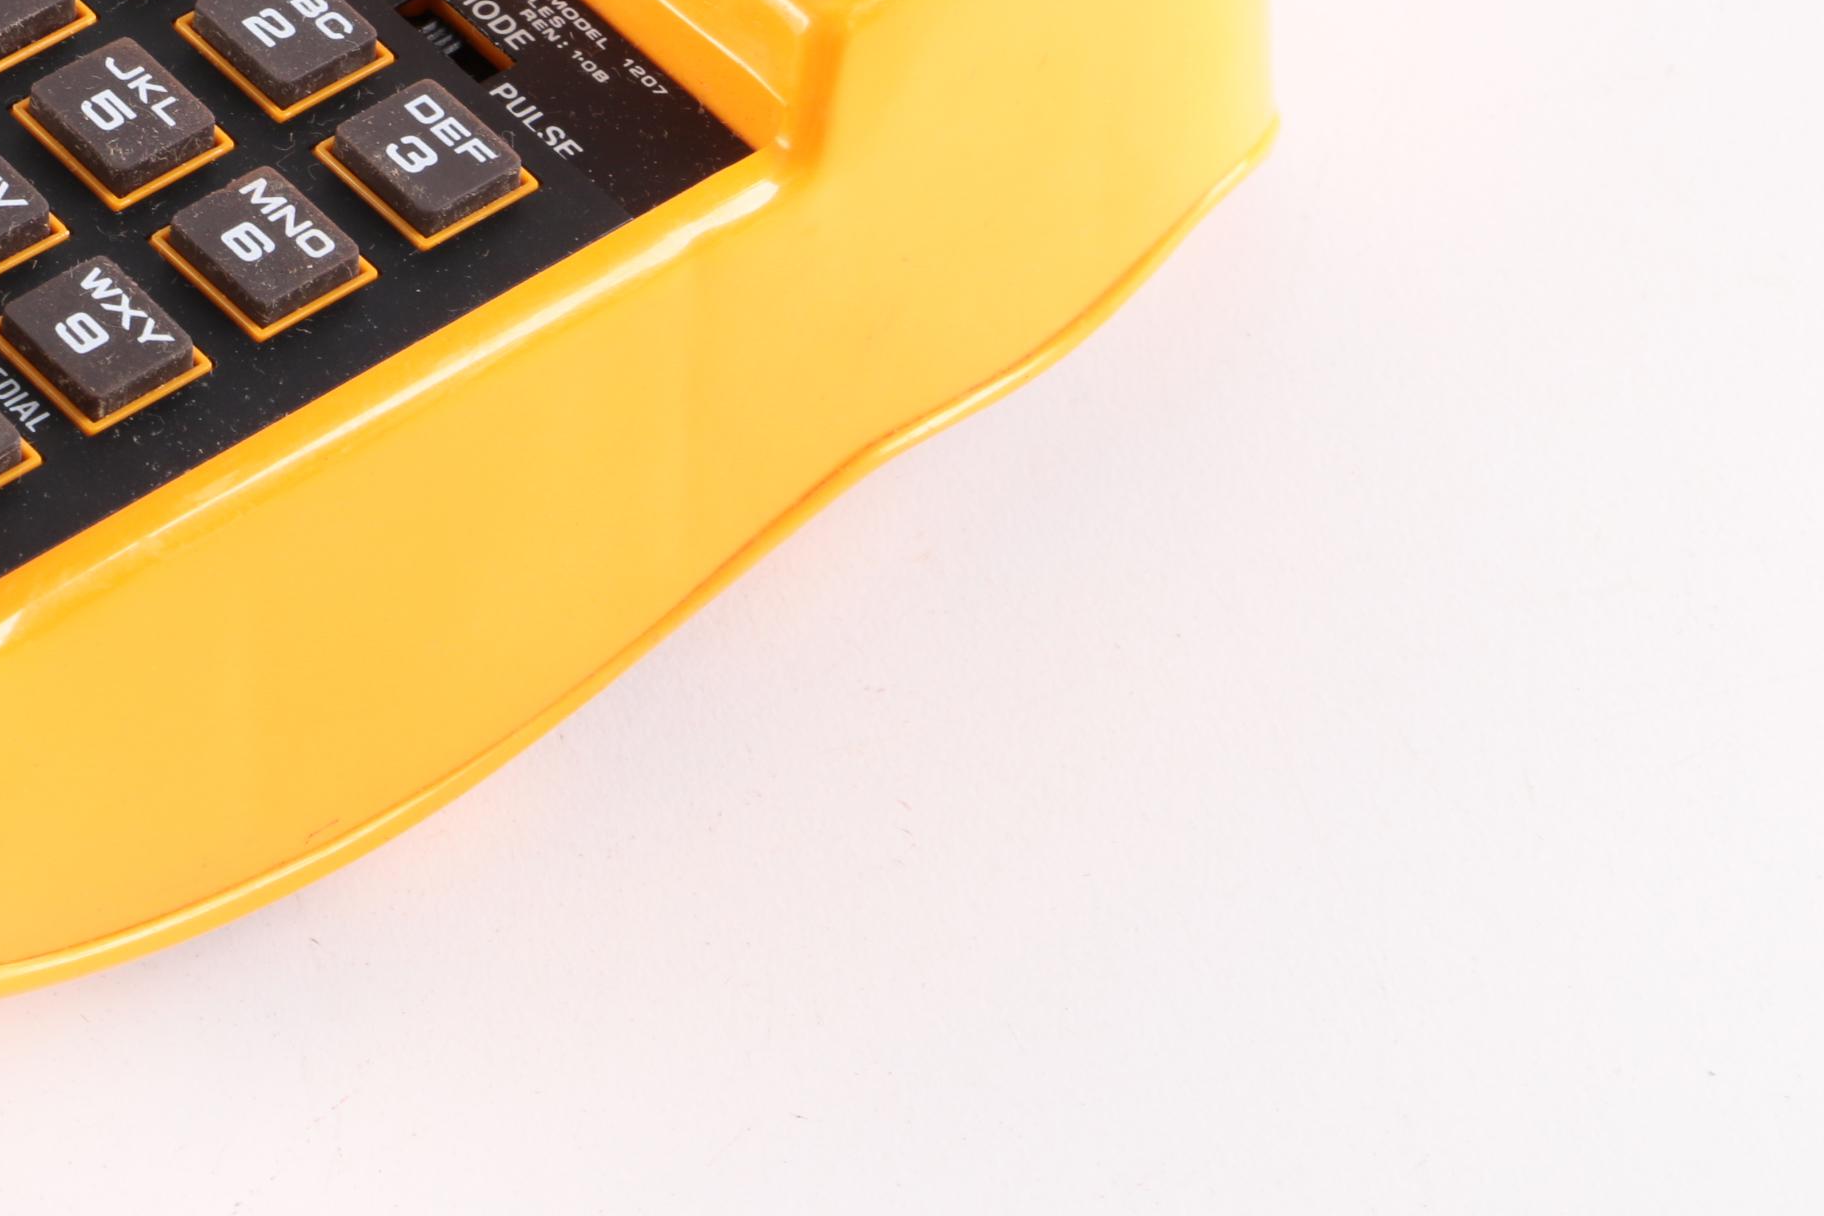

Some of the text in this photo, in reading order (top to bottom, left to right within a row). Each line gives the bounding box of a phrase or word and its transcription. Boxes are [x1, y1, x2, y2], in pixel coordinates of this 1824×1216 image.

[241, 7, 297, 48] 2
[104, 56, 179, 127] JKL
[623, 58, 668, 94] 1207
[80, 88, 138, 131] 5
[403, 94, 499, 163] DEF
[488, 82, 584, 160] PULSE
[385, 135, 439, 174] 3
[238, 177, 336, 259] MNO
[220, 221, 276, 262] 6
[80, 266, 176, 344] WXY
[54, 311, 110, 354] 9
